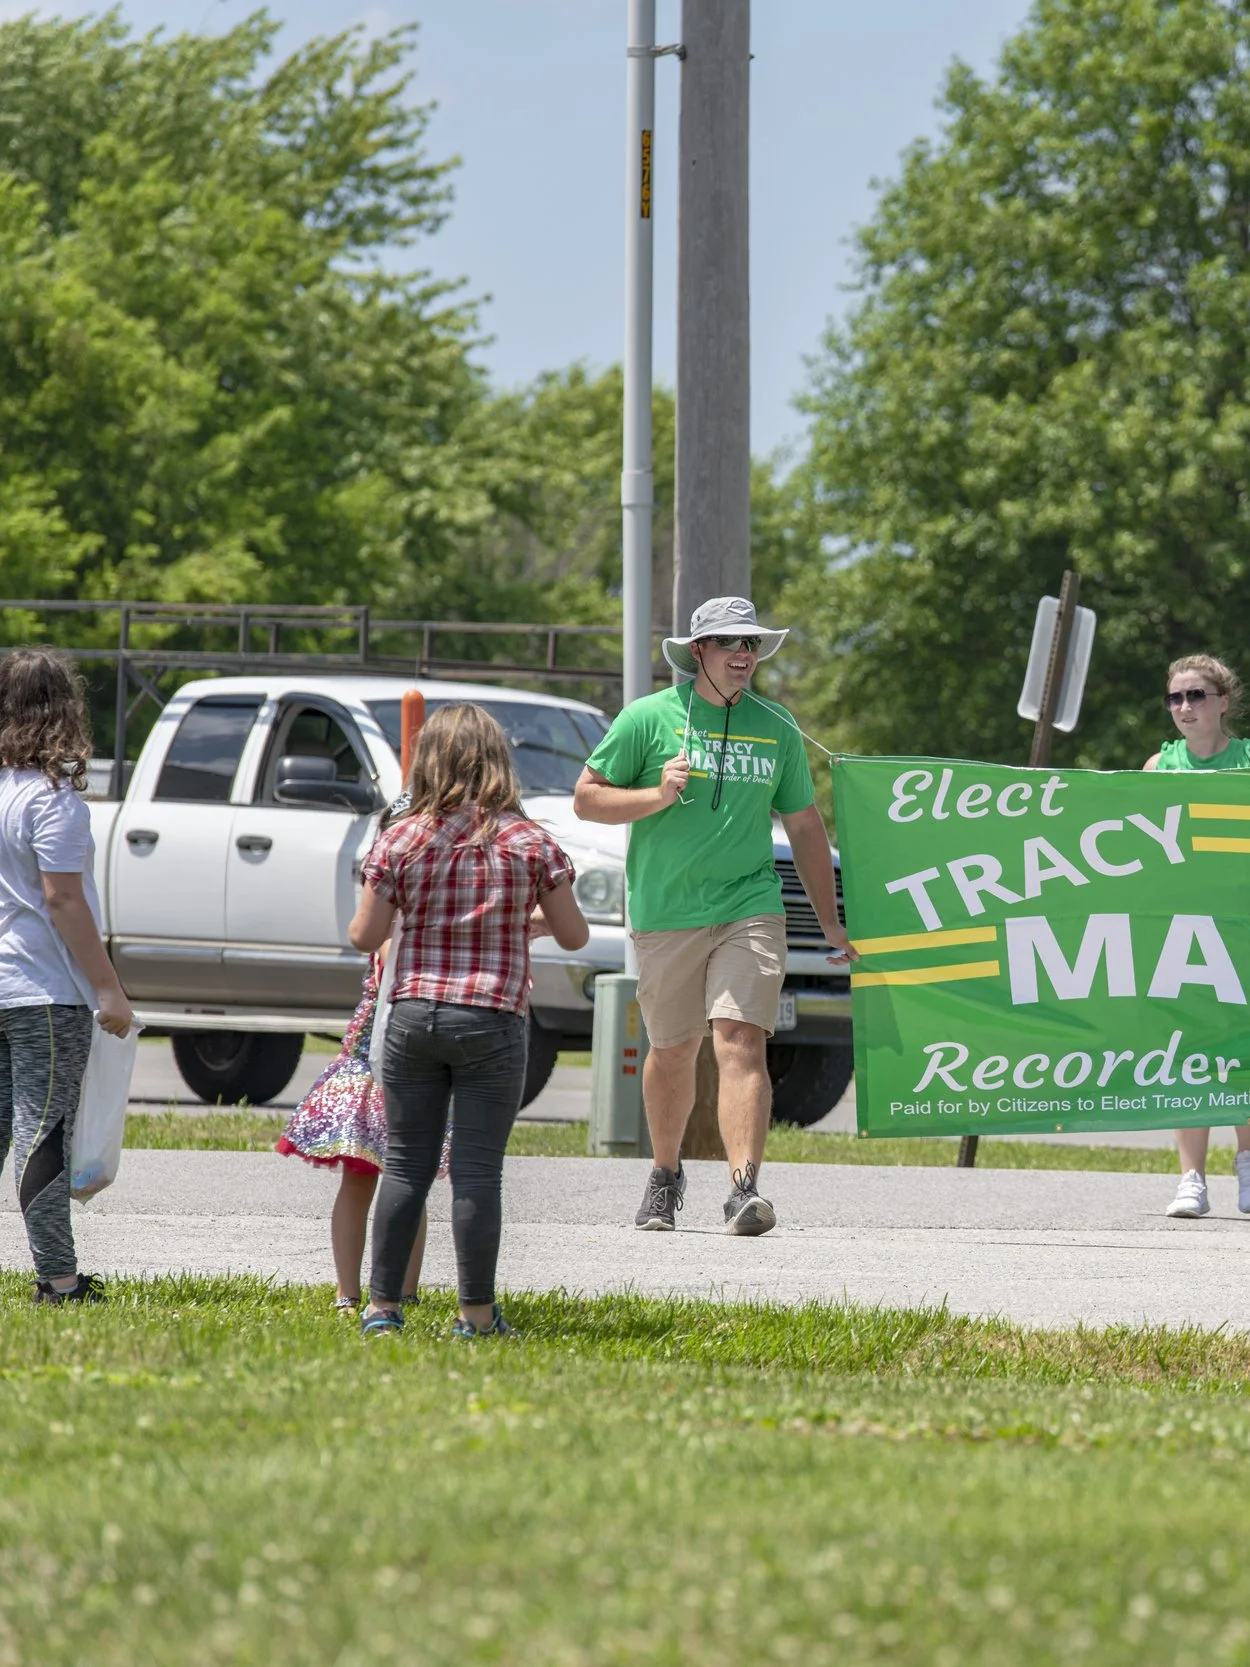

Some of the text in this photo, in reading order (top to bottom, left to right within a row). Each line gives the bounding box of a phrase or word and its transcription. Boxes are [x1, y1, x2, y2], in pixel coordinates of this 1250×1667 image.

[703, 739, 754, 755] TRACY
[687, 749, 776, 779] MARTIN
[708, 770, 741, 782] Reorder
[742, 773, 753, 784] of
[887, 768, 1069, 823] Elect
[885, 804, 1187, 932] TRACY
[912, 1029, 1241, 1093] Recorder
[890, 1100, 932, 1116] Paid
[937, 1099, 961, 1114] for
[968, 1098, 990, 1117] by
[996, 1098, 1071, 1113] Citizens
[1078, 1098, 1095, 1111] to
[1101, 1095, 1147, 1110] Elect
[1152, 1093, 1203, 1111] Tracy
